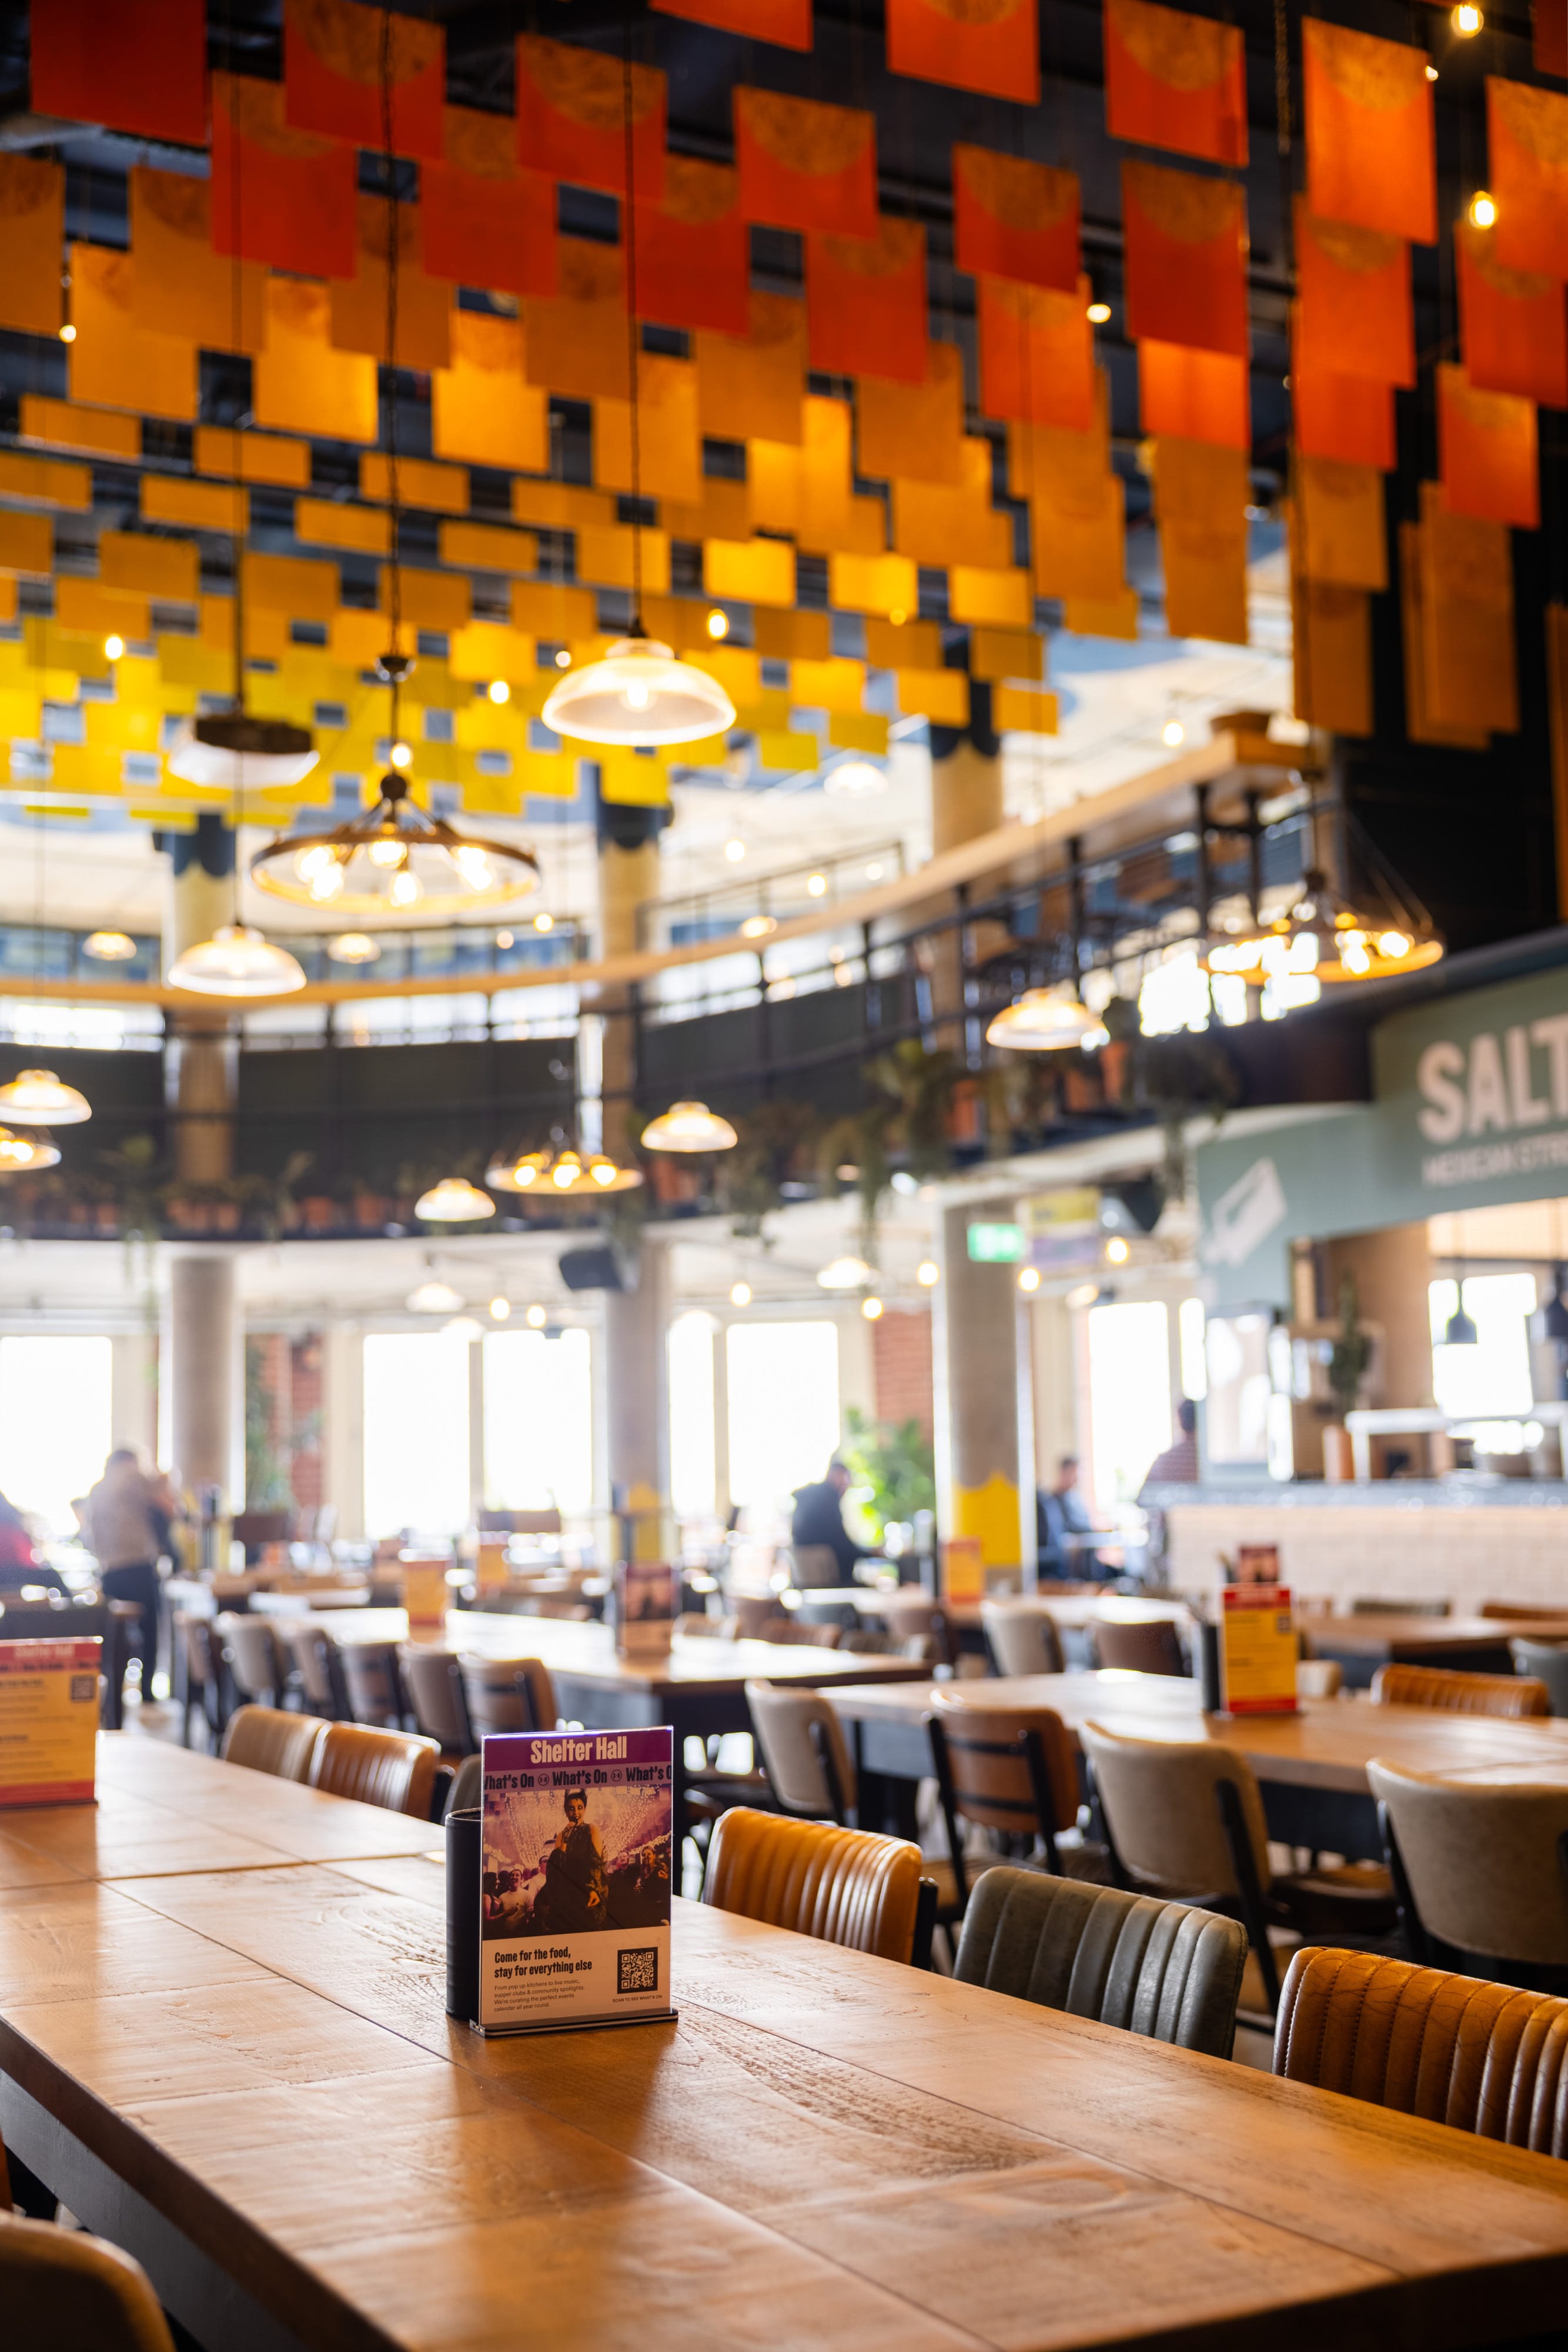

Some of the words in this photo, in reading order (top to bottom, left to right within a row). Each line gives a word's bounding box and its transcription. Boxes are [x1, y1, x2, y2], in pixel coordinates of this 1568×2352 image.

[530, 1738, 593, 1763] Shelter
[596, 1735, 627, 1760] Hall
[520, 1773, 534, 1788] On
[552, 1770, 591, 1786] What's
[594, 1769, 607, 1783] On
[626, 1766, 664, 1782] What's
[494, 1952, 517, 1963] Come
[519, 1950, 532, 1961] for
[534, 1949, 547, 1960] the
[549, 1946, 571, 1959] food,
[494, 1967, 513, 1979] stay
[514, 1965, 527, 1976] for
[529, 1961, 574, 1976] everything
[575, 1959, 592, 1971] else
